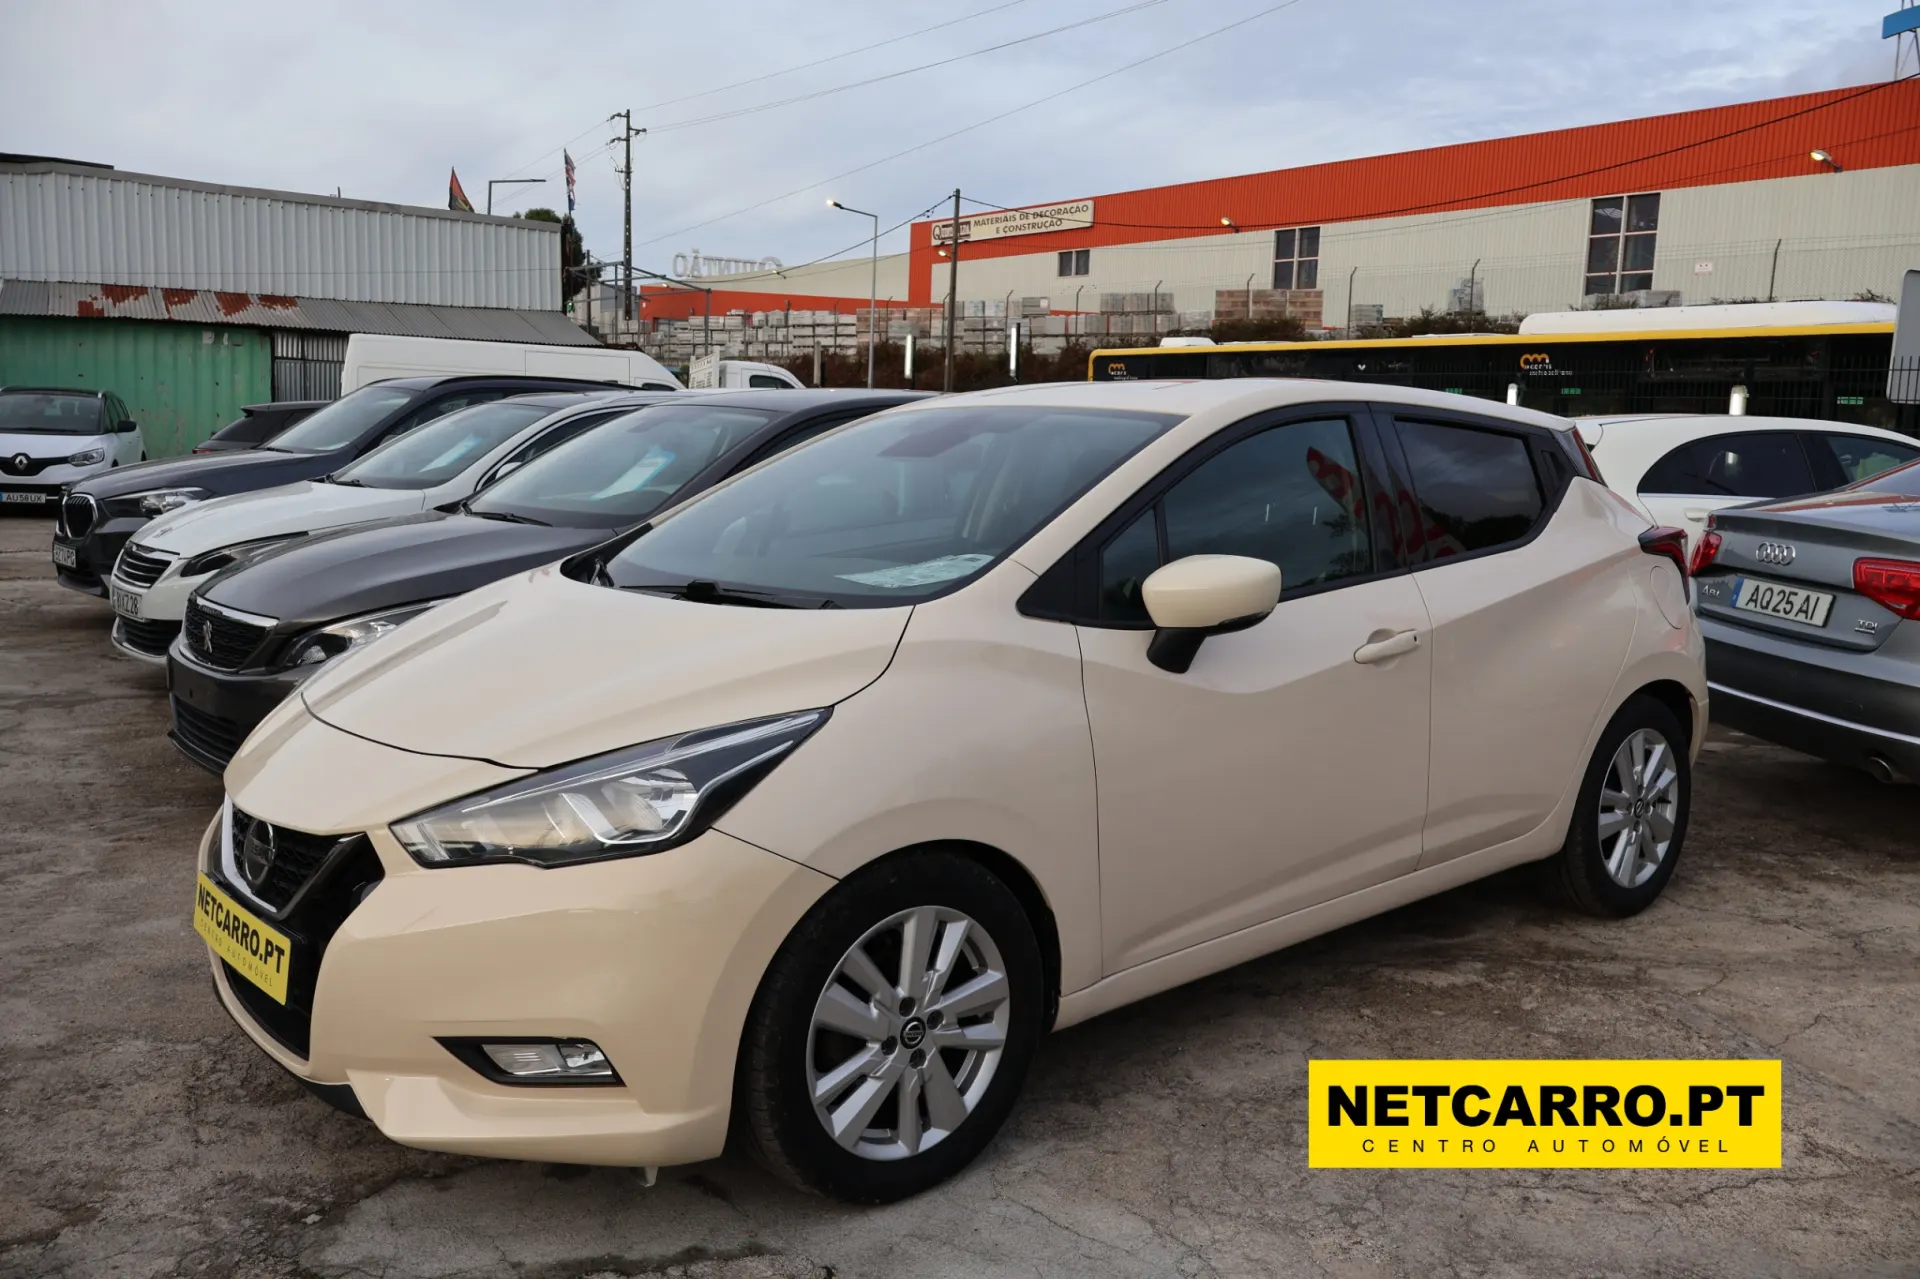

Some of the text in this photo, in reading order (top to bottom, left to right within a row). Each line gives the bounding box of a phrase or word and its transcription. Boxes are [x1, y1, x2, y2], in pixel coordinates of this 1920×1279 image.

[973, 203, 1089, 227] MATERIAIS DE DECORAÇÃO
[996, 218, 1063, 235] E CONSTRUÇÃO
[1745, 584, 1820, 621] AQ25AI
[1857, 619, 1878, 631] TDI
[197, 883, 285, 974] NETCARRO.PT
[200, 918, 273, 987] CENTRO AUTOMÓVEL
